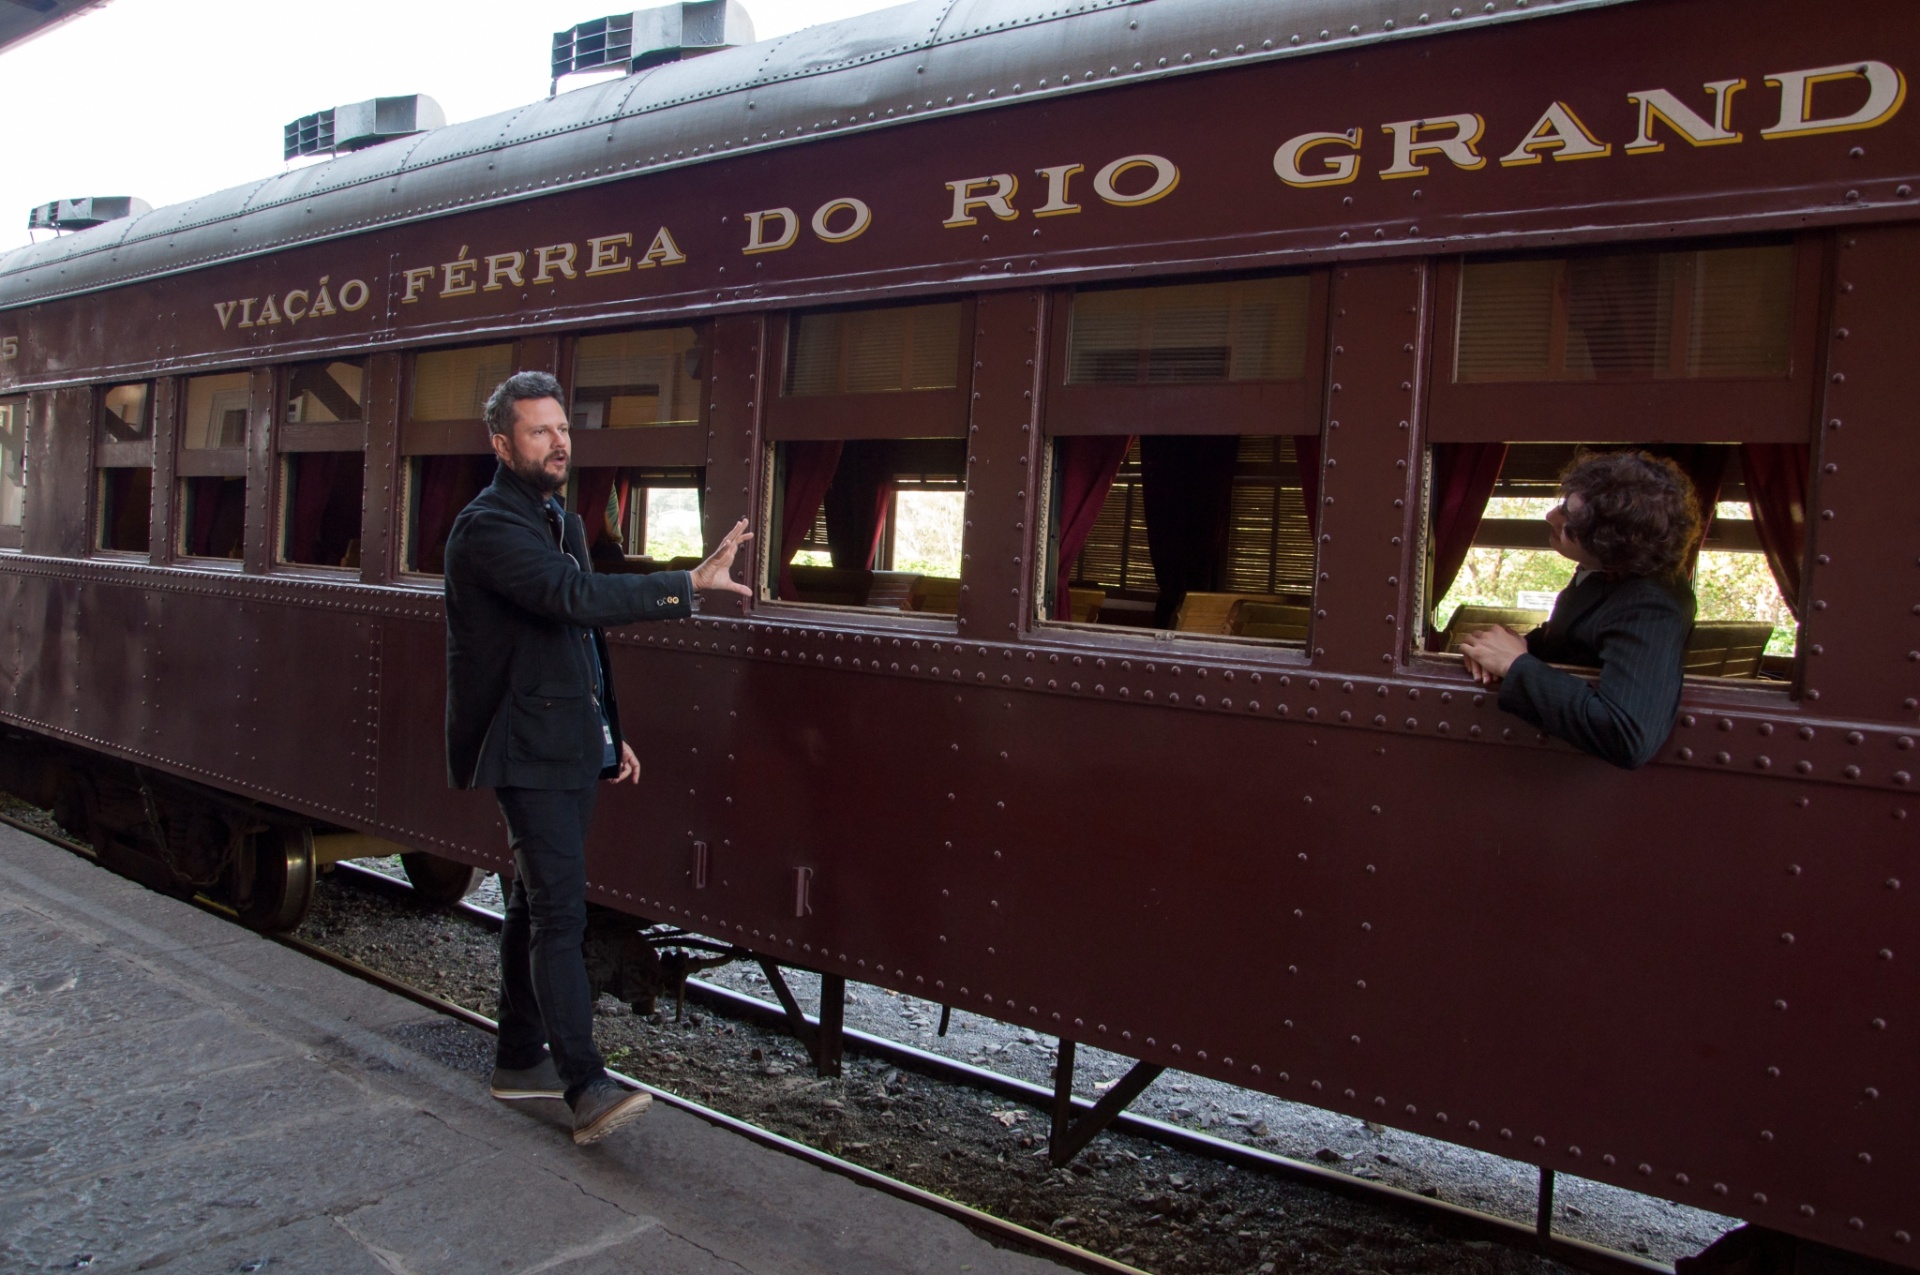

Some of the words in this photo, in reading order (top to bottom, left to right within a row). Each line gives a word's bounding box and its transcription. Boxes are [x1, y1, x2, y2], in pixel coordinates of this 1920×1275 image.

[401, 226, 687, 304] FÉRREA
[742, 197, 872, 256] DO
[942, 154, 1181, 229] RIO
[1273, 60, 1907, 188] GRAND
